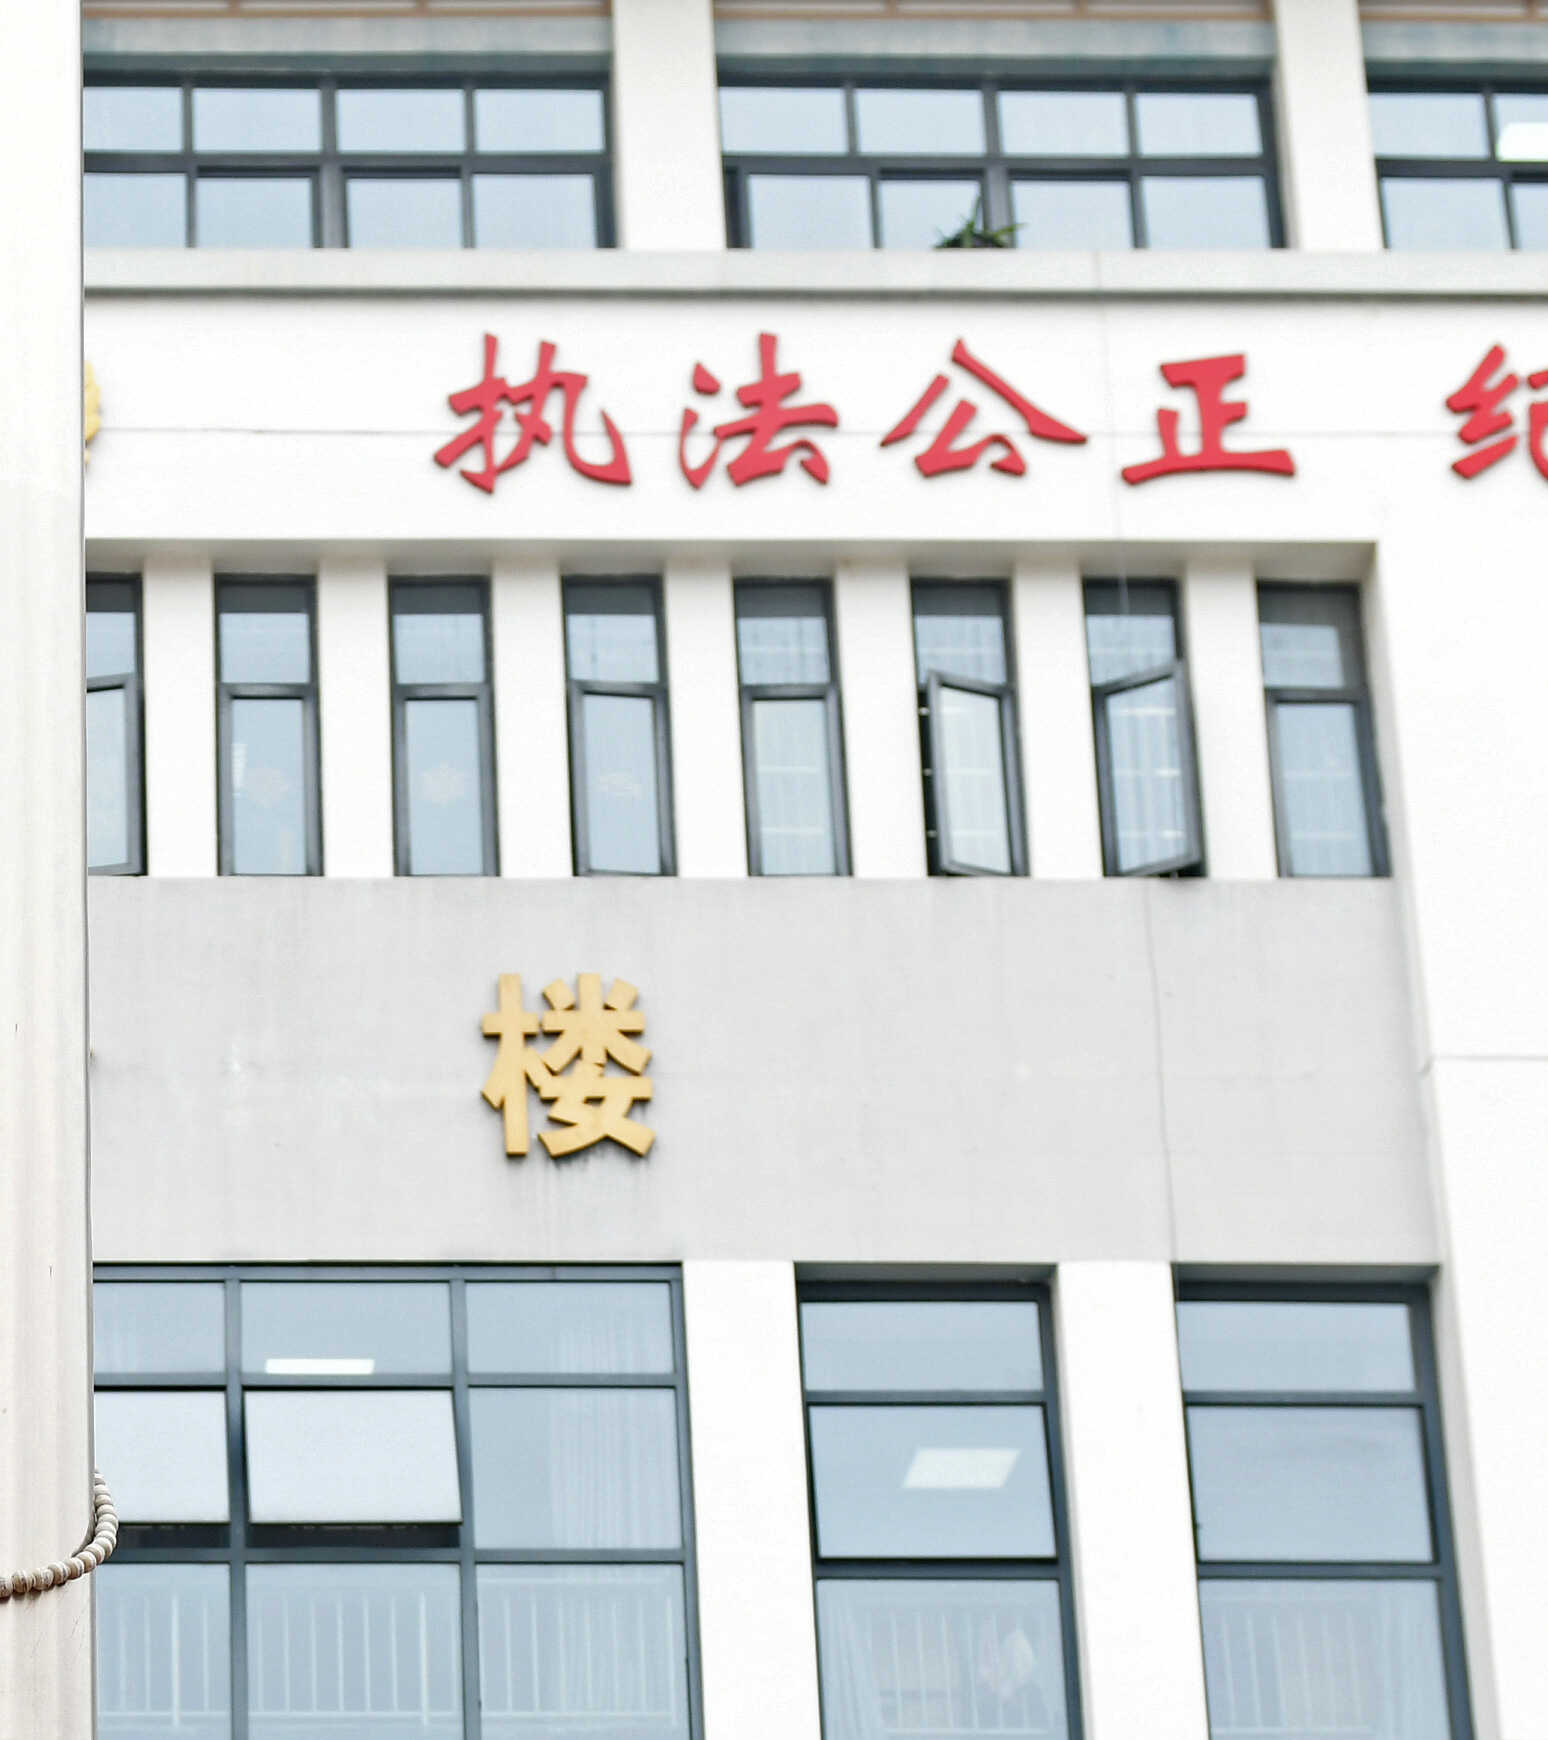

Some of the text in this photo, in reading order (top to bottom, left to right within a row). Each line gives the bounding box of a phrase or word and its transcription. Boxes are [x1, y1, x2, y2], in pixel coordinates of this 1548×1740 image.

[434, 331, 1297, 494] 执法公正
[480, 971, 658, 1160] 楼
